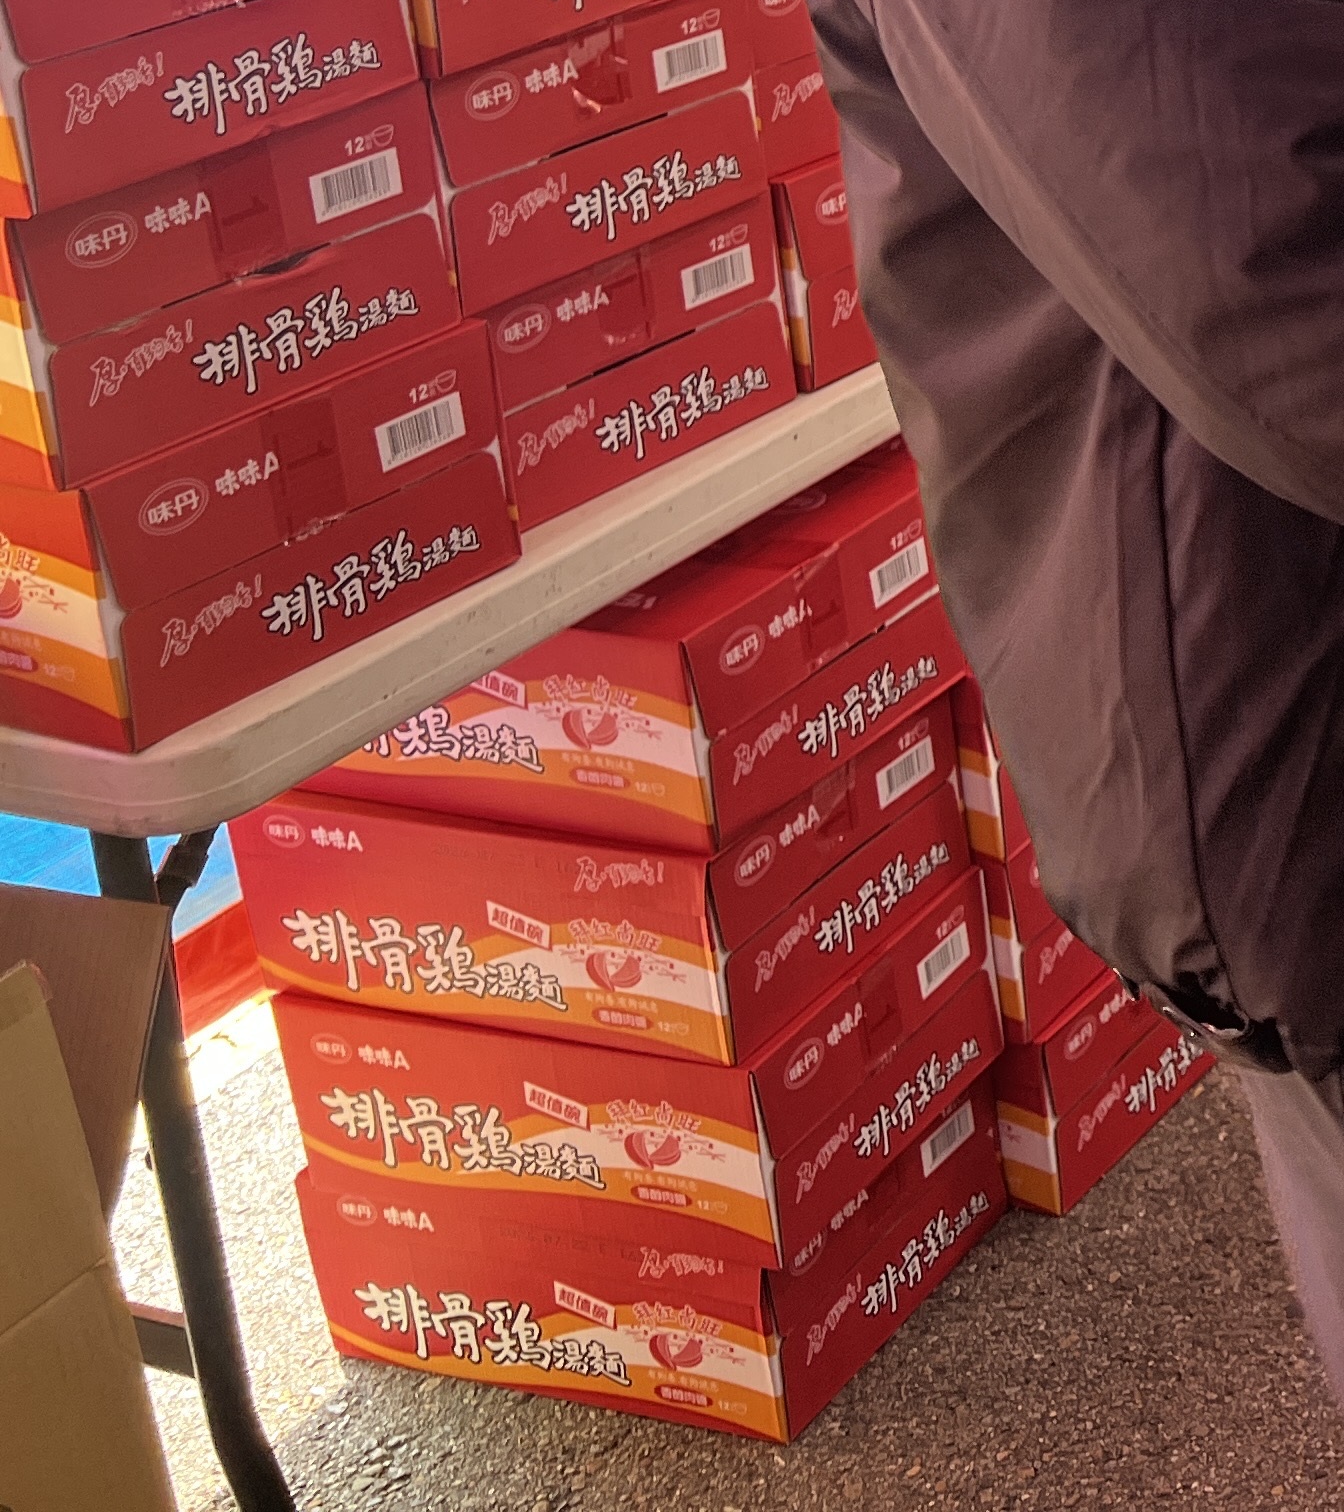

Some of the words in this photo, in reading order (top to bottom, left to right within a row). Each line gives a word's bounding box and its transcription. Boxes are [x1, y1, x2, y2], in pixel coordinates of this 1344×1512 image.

[682, 18, 697, 33] 12
[473, 83, 512, 108] 味丹
[526, 58, 577, 92] 味味A
[345, 138, 363, 156] 12
[75, 227, 127, 256] 味丹
[144, 193, 211, 233] 味味A
[709, 236, 723, 251] 12
[504, 317, 542, 342] 味丹
[409, 385, 428, 403] 12
[147, 493, 199, 523] 味丹
[216, 453, 279, 495] 味味A
[726, 629, 758, 671] 味丹
[311, 828, 363, 851] 味味A
[741, 847, 770, 879] 味丹
[492, 907, 545, 942] 超值碗
[358, 1045, 410, 1070] 味味A
[784, 1045, 819, 1081] 味丹
[529, 1089, 582, 1124] 超值碗
[384, 1209, 433, 1232] 味味A
[559, 1288, 609, 1322] 超值碗
